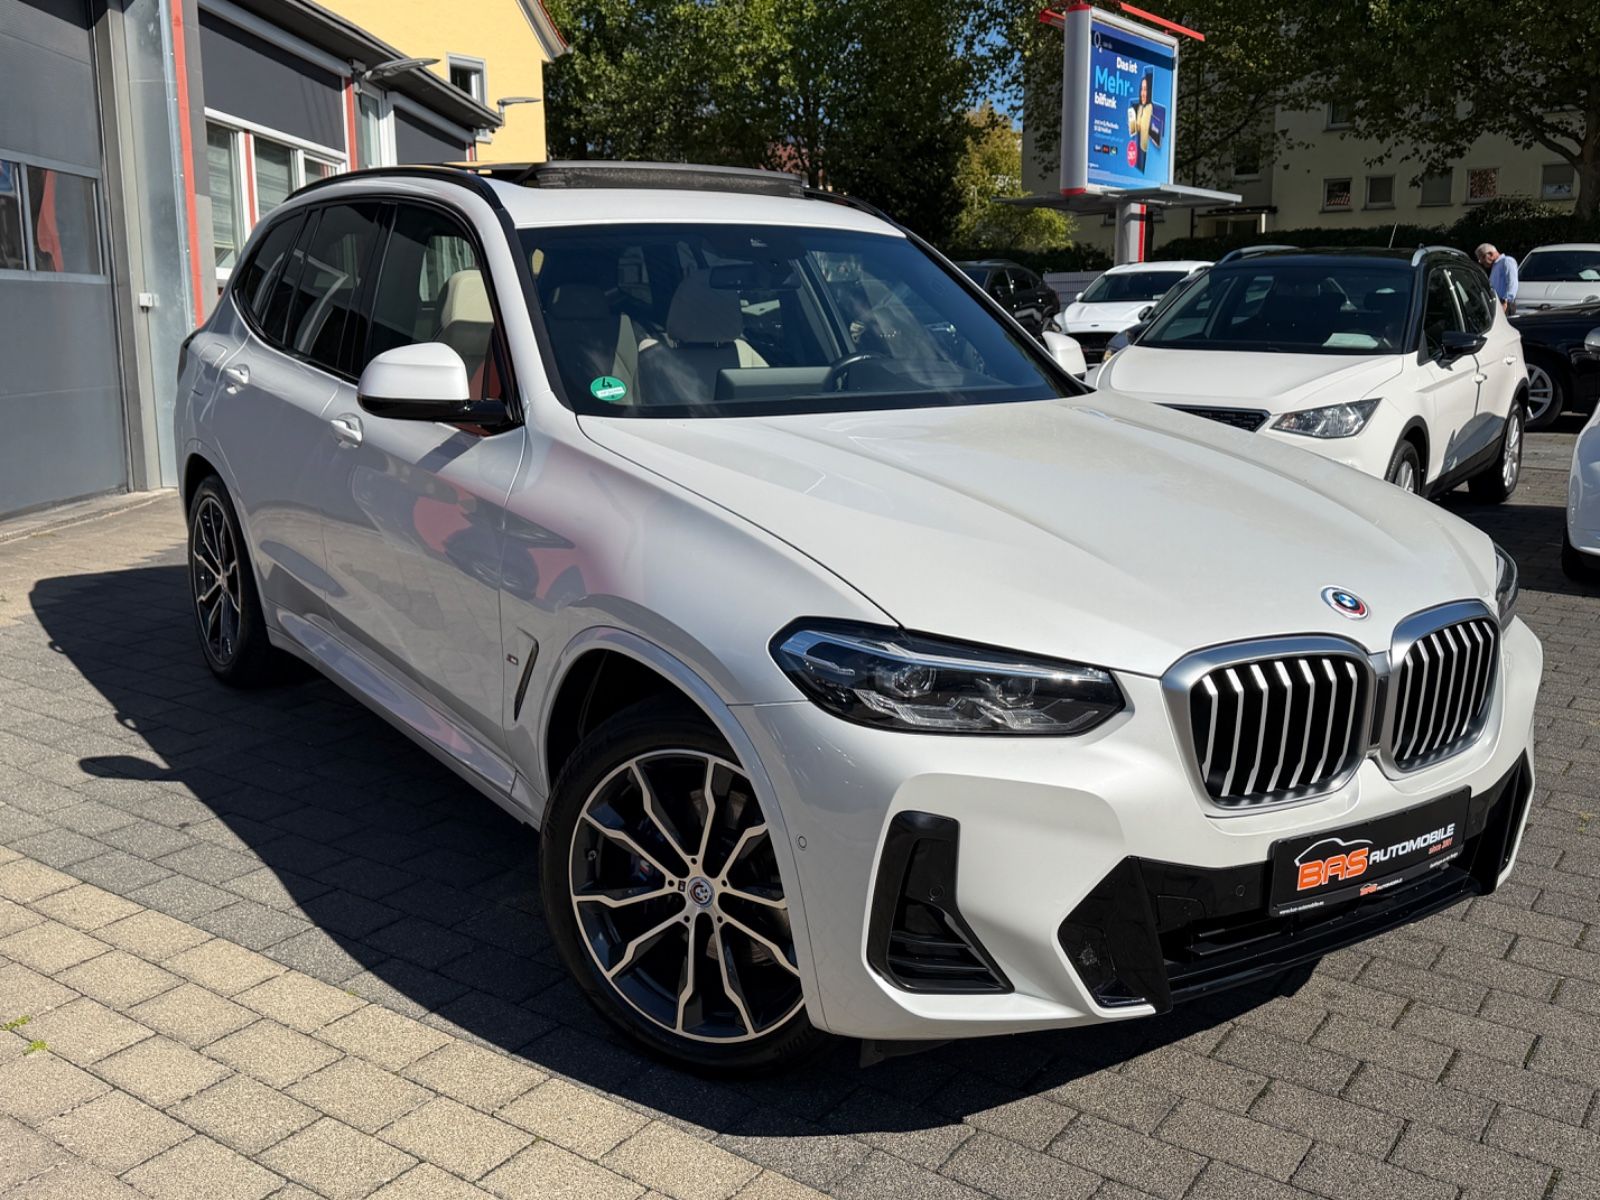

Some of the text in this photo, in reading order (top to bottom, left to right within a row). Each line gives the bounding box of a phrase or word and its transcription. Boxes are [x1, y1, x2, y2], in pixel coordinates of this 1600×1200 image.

[1095, 65, 1134, 97] Mehr-
[1116, 56, 1138, 74] Das ist
[1297, 823, 1455, 891] BAS AUTOMOBILE
